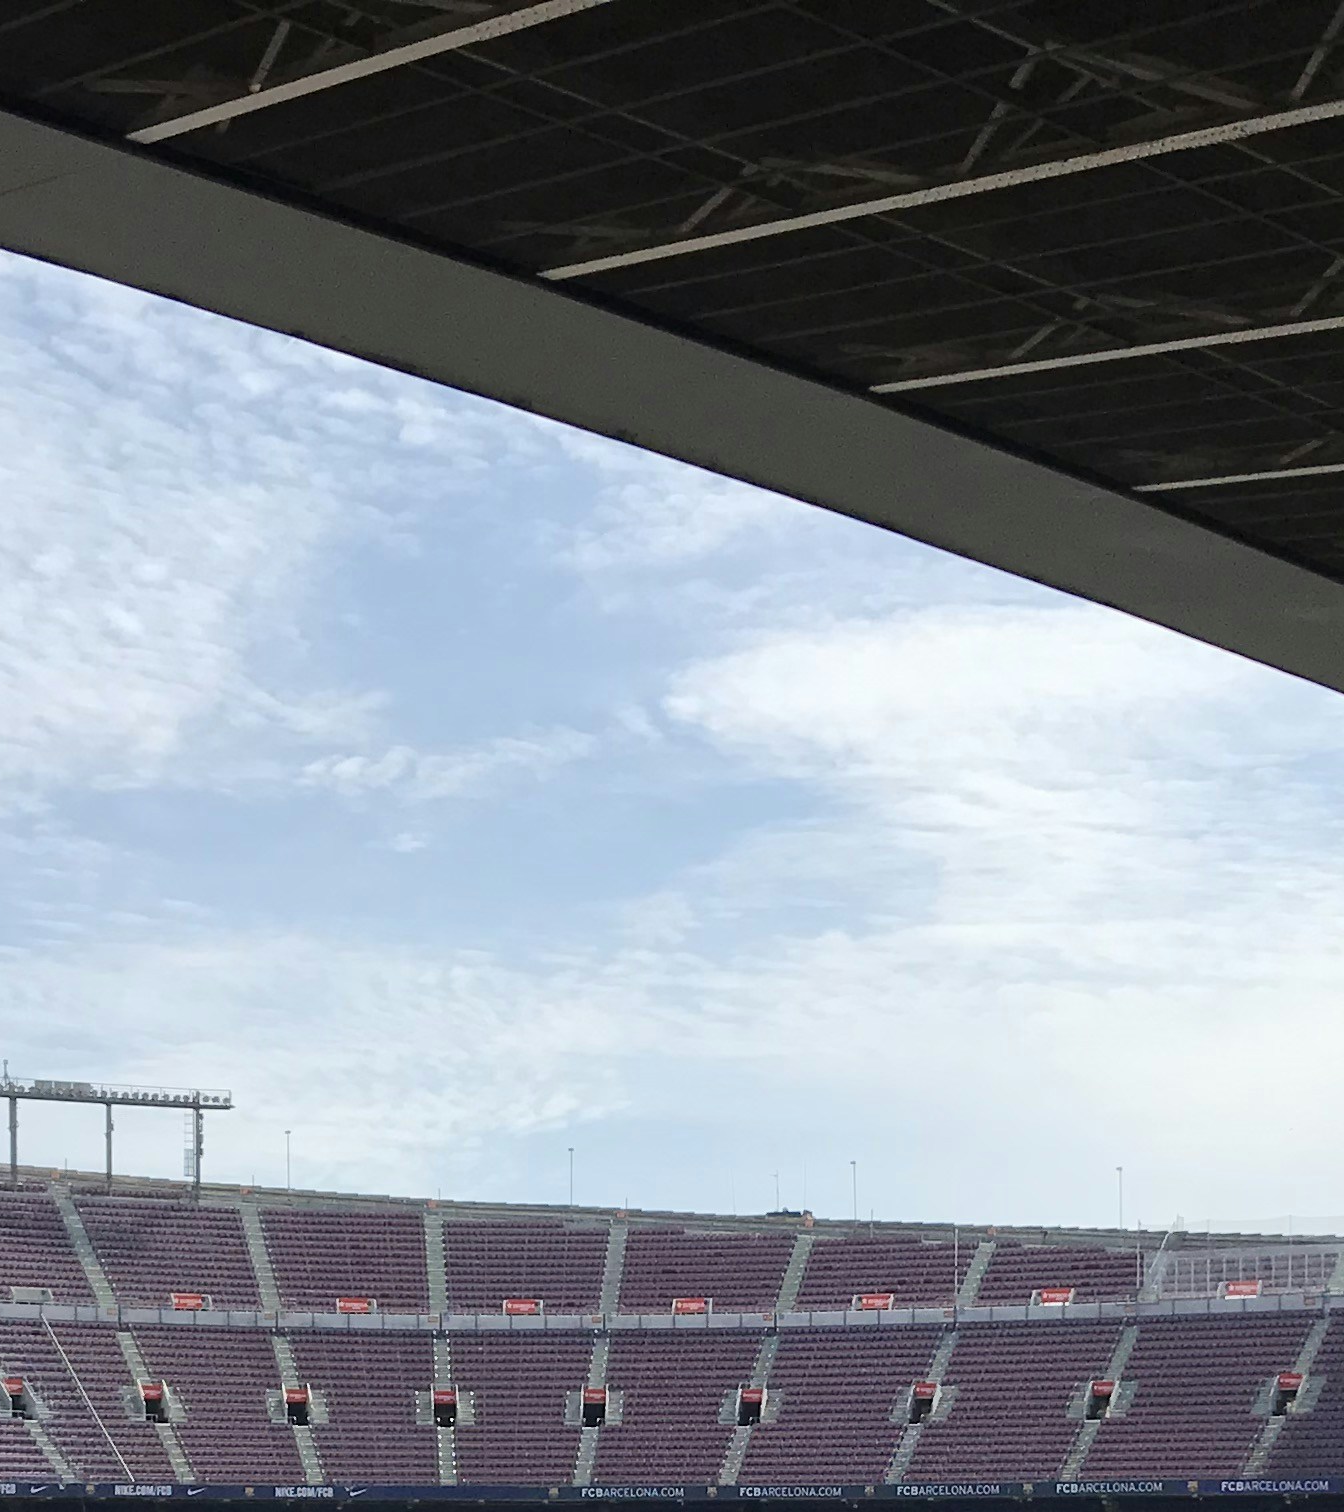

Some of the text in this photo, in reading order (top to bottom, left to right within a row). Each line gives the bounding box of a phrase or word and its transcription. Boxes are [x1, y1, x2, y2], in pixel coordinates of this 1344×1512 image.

[114, 1483, 172, 1496] NIKE.COM/FCB
[275, 1485, 334, 1498] NIKE.COM/FCB
[739, 1486, 842, 1497] FCBARCELONA.COM
[896, 1484, 1000, 1496] FCBARCELONA.COM
[1056, 1482, 1163, 1494] FCBARCELONA.COM
[1221, 1480, 1329, 1492] FCBARCELONA.COM
[581, 1487, 684, 1498] FCBARCELONA.COM
